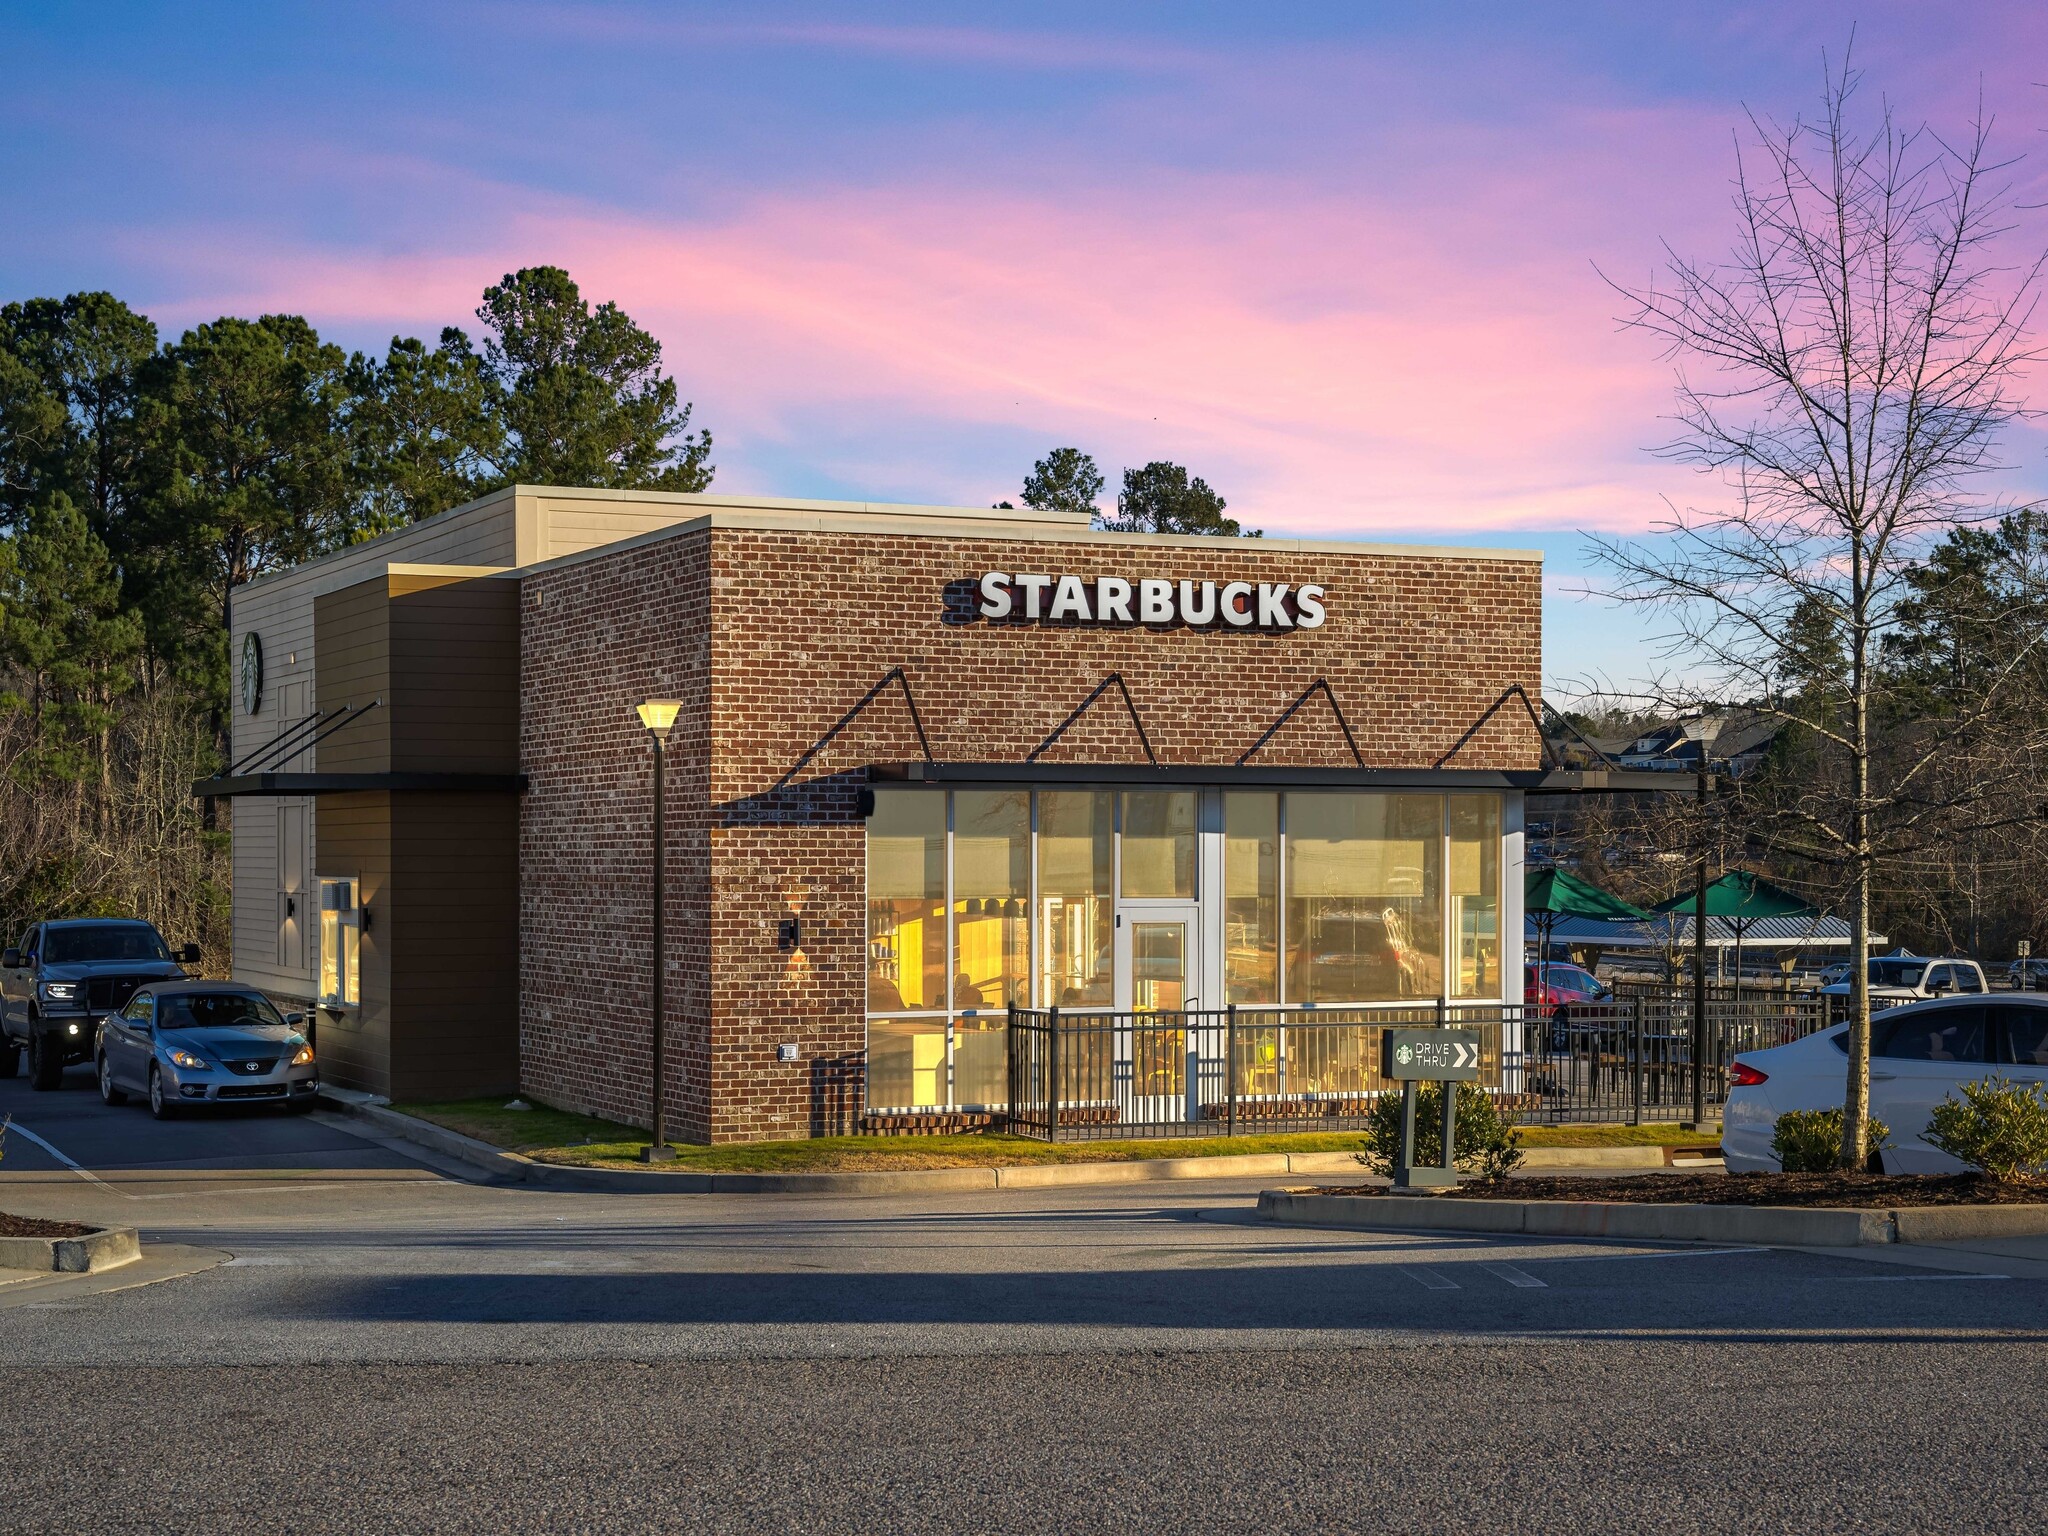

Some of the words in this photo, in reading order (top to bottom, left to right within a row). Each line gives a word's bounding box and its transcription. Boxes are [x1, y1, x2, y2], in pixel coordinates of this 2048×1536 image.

[979, 571, 1326, 629] STARBUCKS
[1415, 1042, 1450, 1055] DRIVE
[1415, 1055, 1447, 1067] THRU
